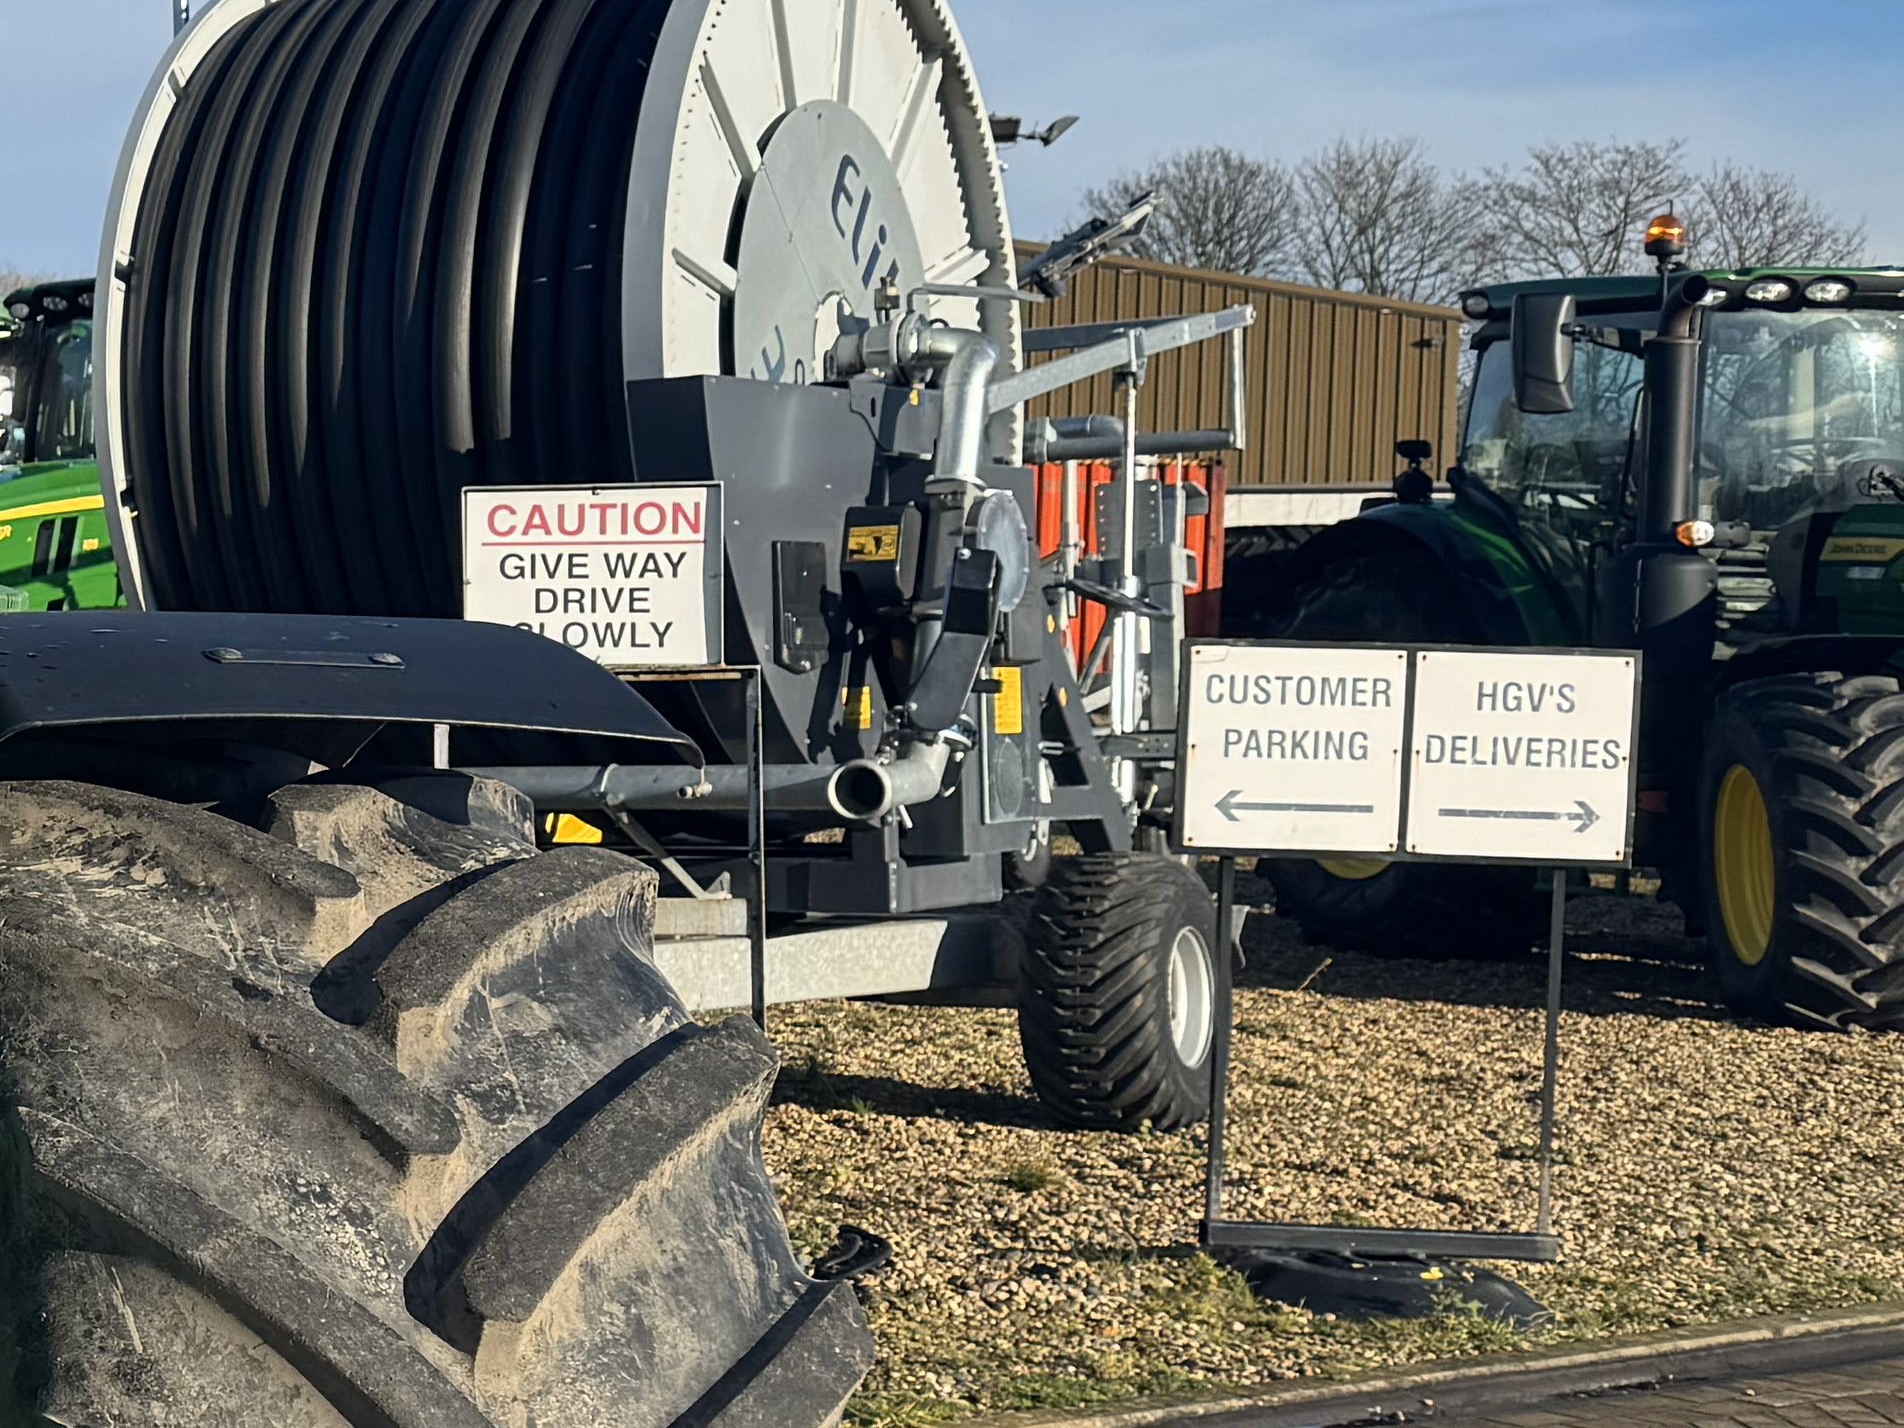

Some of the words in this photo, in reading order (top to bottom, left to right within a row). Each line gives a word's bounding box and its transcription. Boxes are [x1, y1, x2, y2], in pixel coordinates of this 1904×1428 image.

[486, 501, 702, 537] CAUTION
[498, 552, 590, 580] GIVE
[603, 551, 688, 579] WAY
[534, 587, 652, 614] DRIVE
[513, 621, 674, 649] OWLY
[1205, 673, 1394, 708] CUSTOMER
[1476, 681, 1577, 714] HGV'S
[1223, 728, 1370, 761] PARKING
[1424, 733, 1623, 771] DELIVERIES
